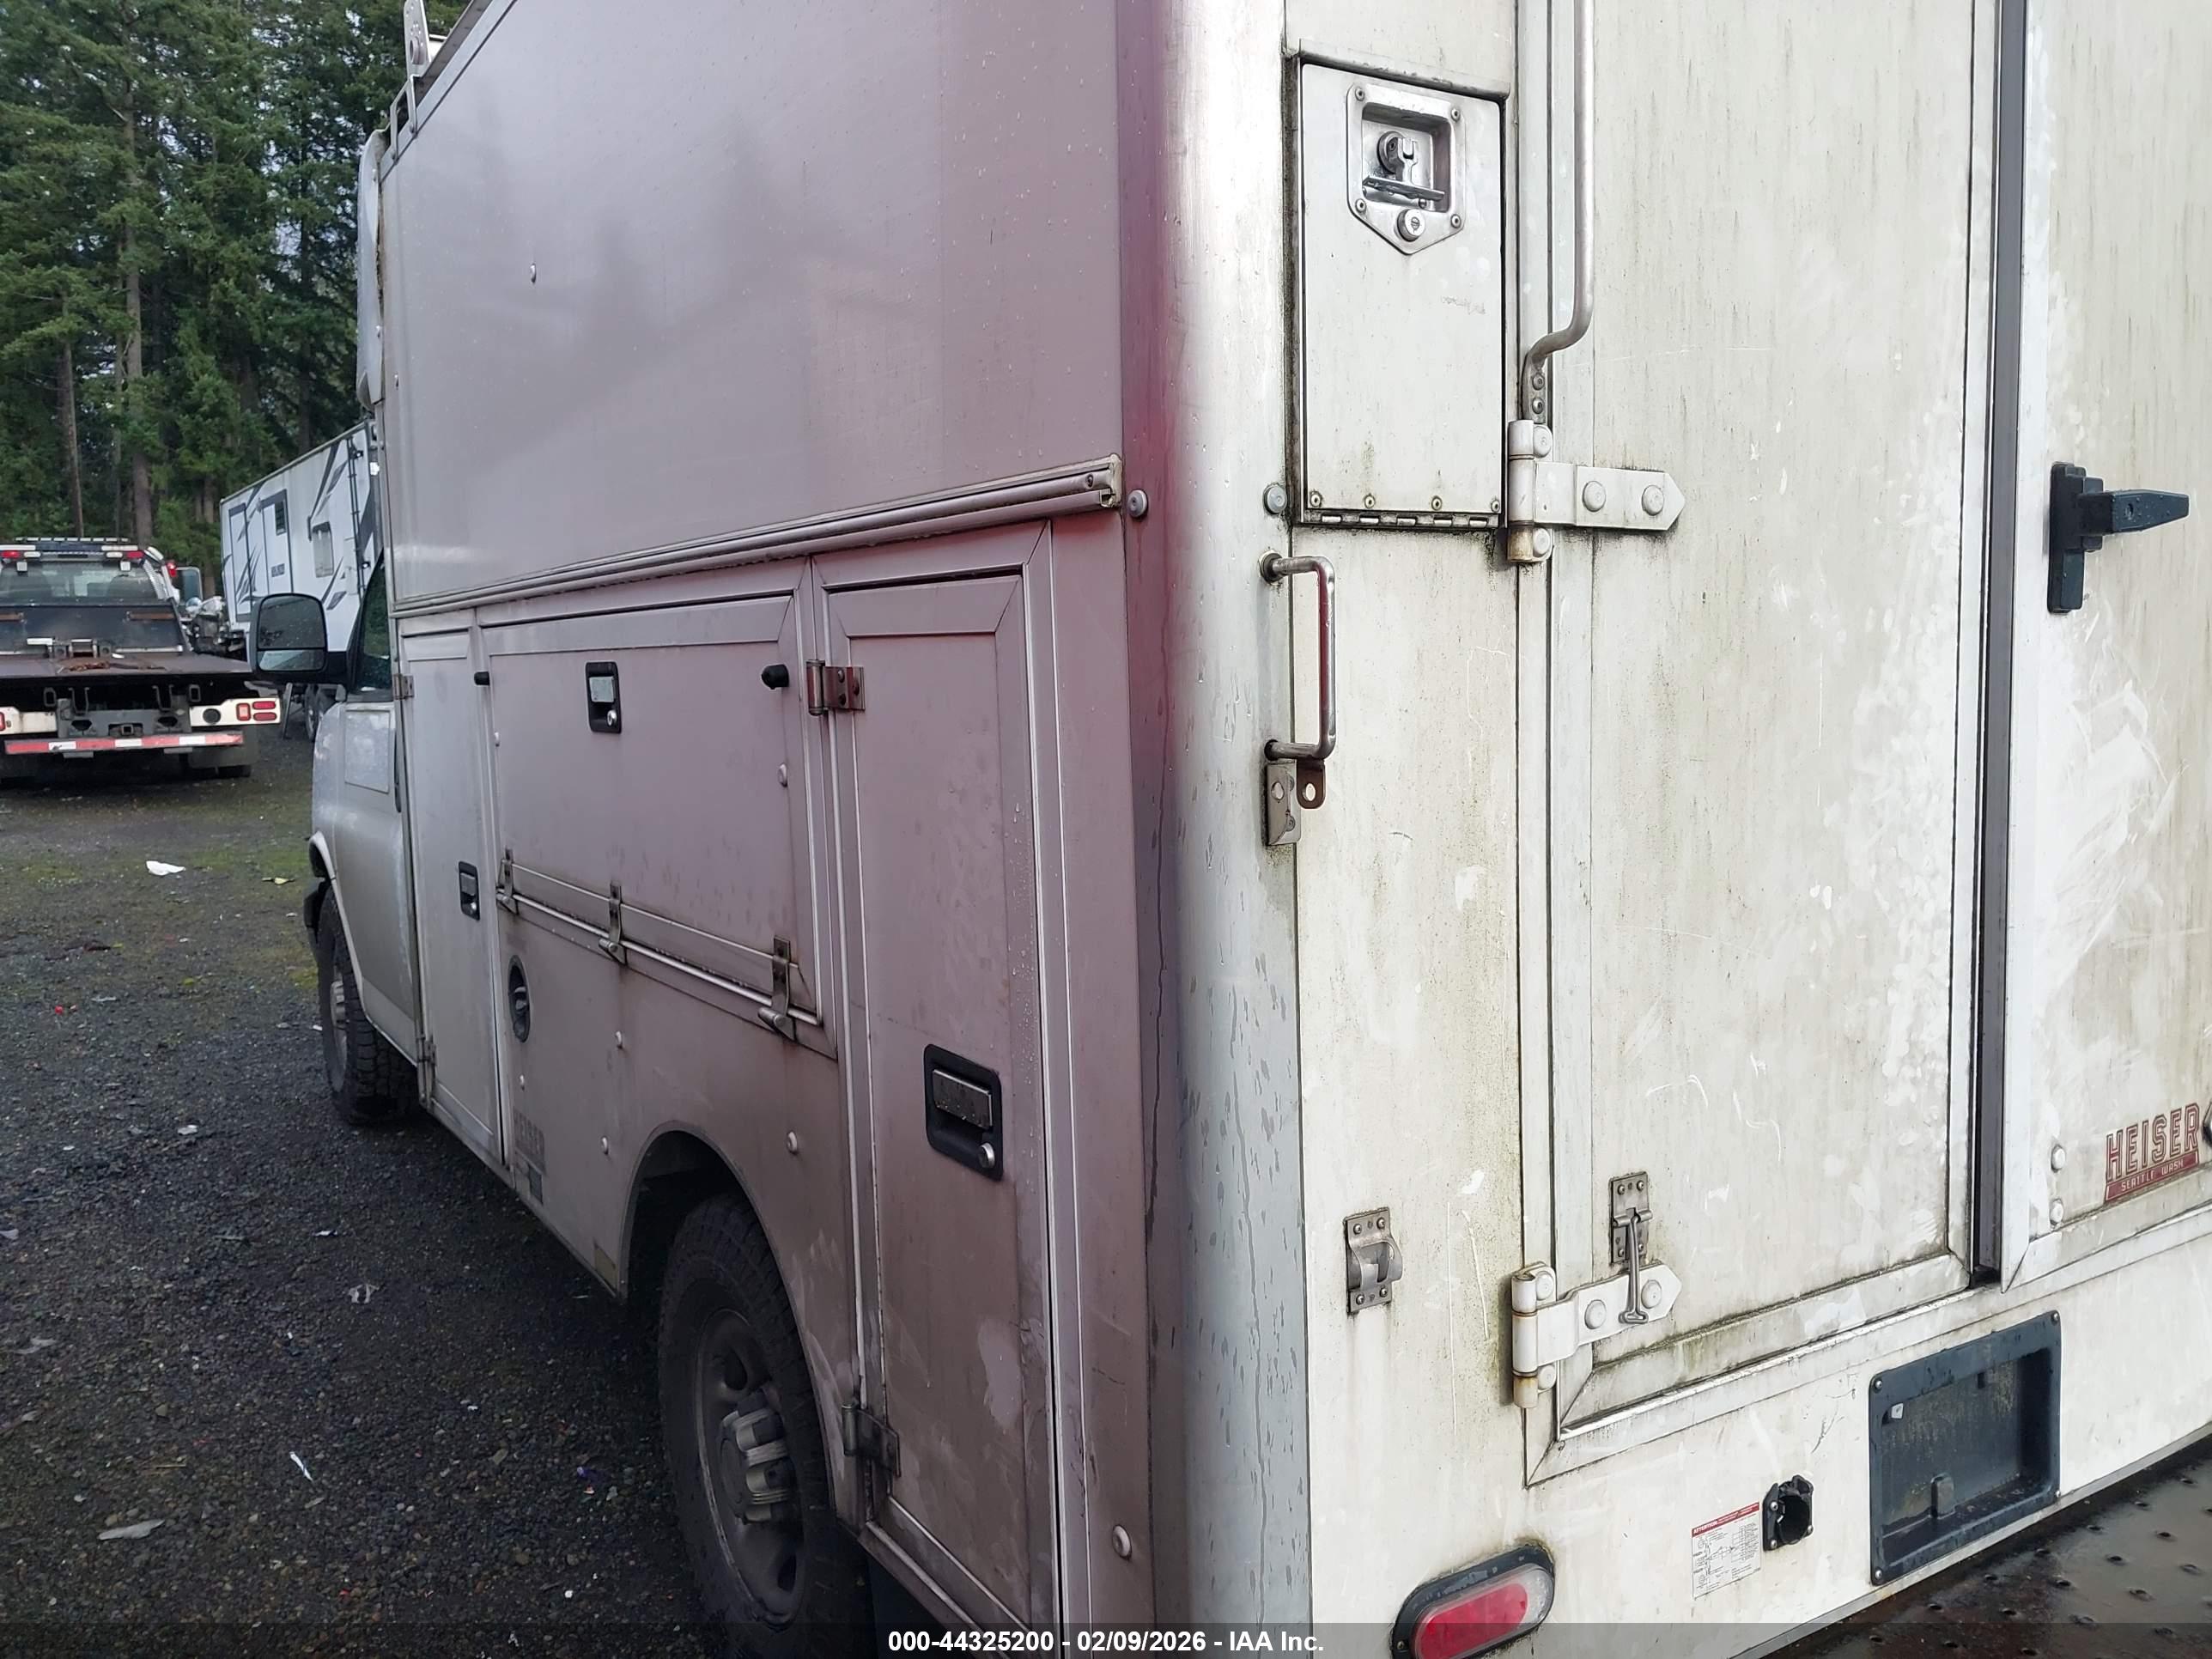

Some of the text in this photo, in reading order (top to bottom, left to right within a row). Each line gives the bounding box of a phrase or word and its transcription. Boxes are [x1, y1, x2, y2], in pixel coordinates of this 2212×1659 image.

[2106, 1103, 2200, 1182] HEISER
[2121, 1159, 2184, 1191] SEATTLE WASH
